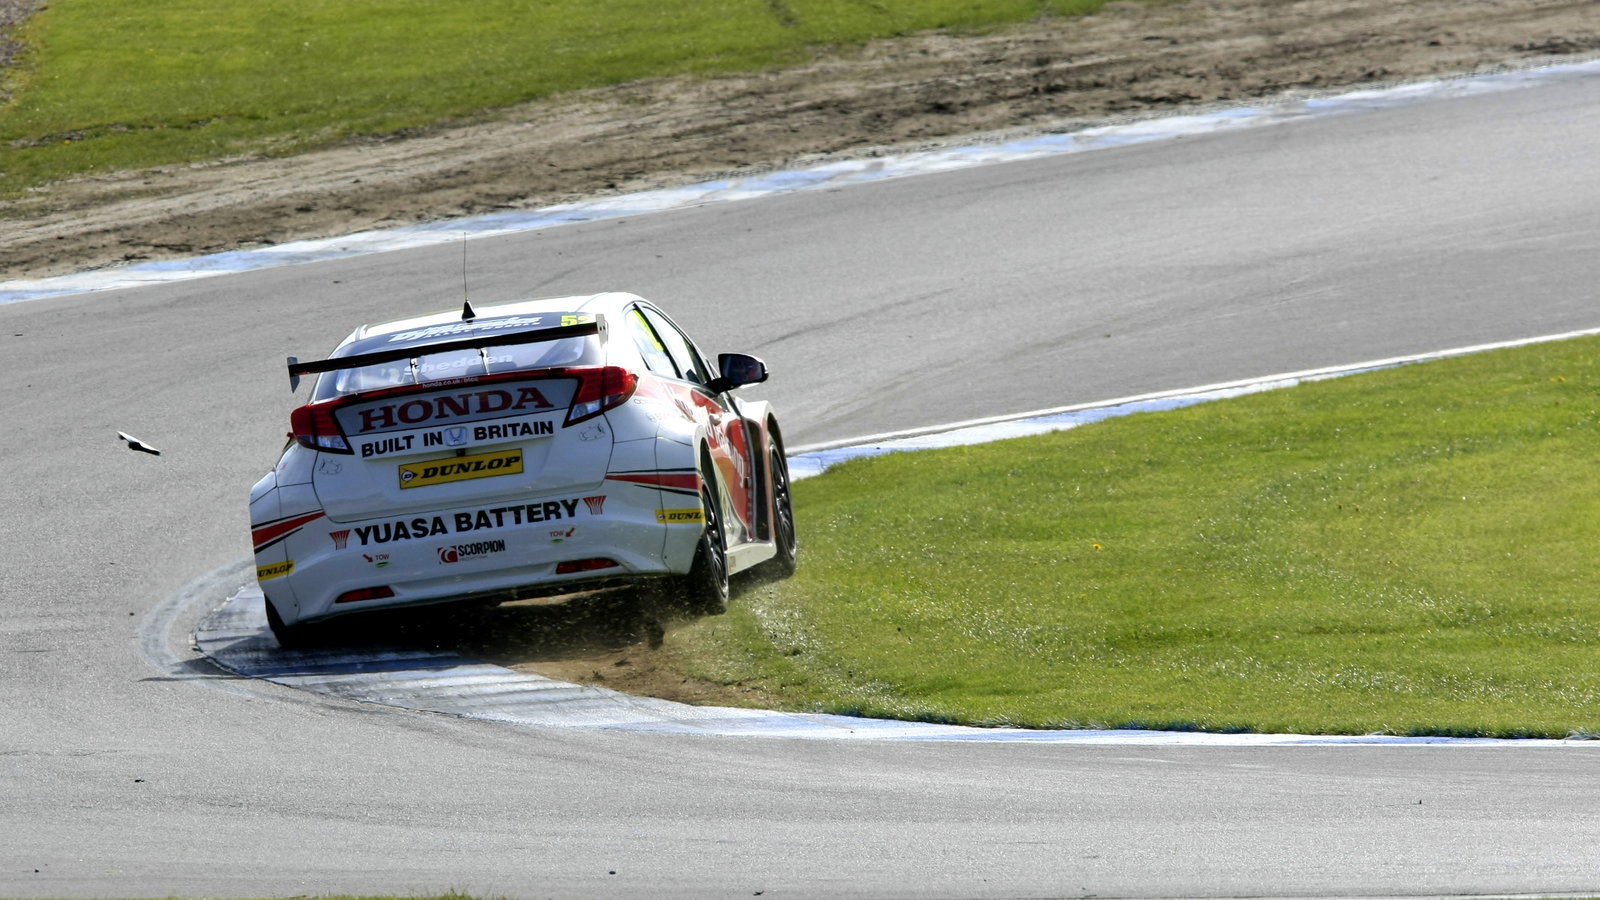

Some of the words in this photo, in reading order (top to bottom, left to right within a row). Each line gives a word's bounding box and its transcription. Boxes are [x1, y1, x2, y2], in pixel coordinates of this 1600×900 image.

[358, 387, 554, 432] HONDA
[361, 435, 414, 458] BUILT
[423, 431, 443, 447] IN
[474, 420, 554, 440] BRITAIN
[421, 456, 521, 479] DUNLOP
[354, 516, 448, 546] YUASA
[454, 498, 580, 533] BATTERY
[457, 539, 505, 556] SCORPION
